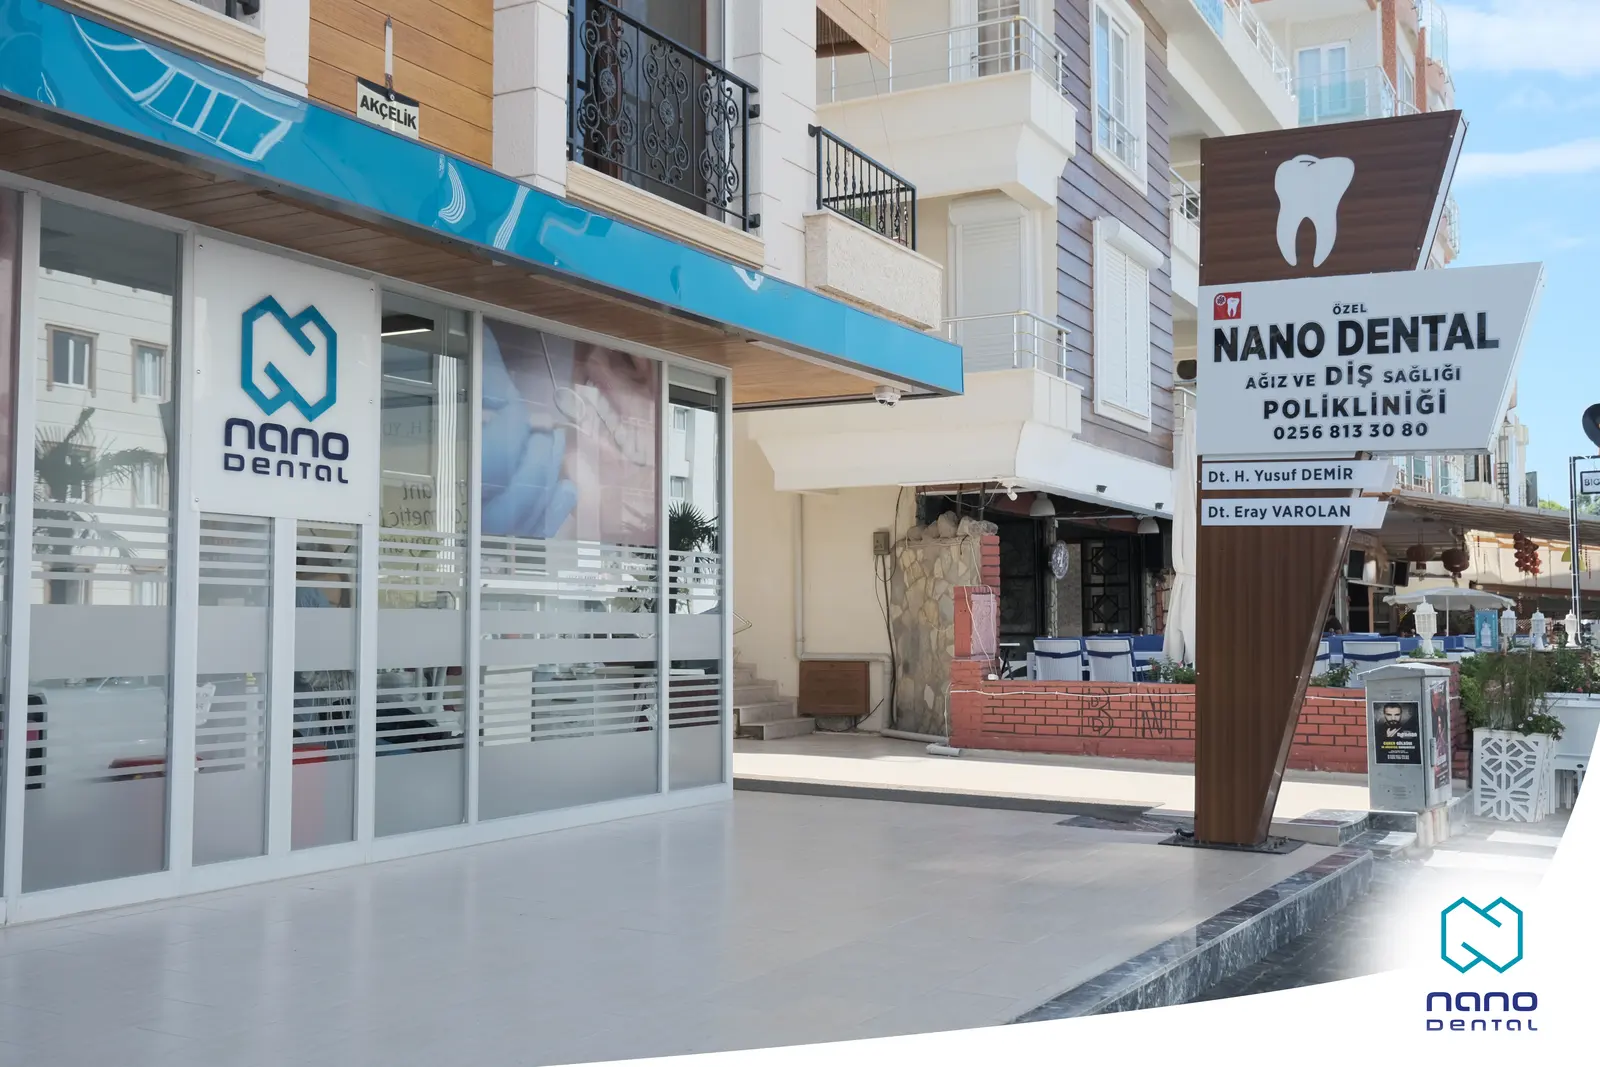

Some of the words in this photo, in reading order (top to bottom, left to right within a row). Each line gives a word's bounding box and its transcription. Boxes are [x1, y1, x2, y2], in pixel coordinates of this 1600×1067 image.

[360, 95, 417, 130] AKÇELİK
[1332, 303, 1367, 315] ÖZEL
[1214, 322, 1325, 362] NANO
[1338, 312, 1499, 356] DENTAL
[1245, 372, 1288, 389] AĞIZ
[1293, 374, 1316, 388] VE
[1325, 361, 1373, 388] DİŞ
[1383, 364, 1461, 383] SAĞLIĞI
[1264, 388, 1446, 419] POLİKLİNİĞİ
[1273, 425, 1322, 440] 0256
[1329, 424, 1362, 438] 813
[1370, 423, 1394, 437] 30
[1401, 422, 1428, 437] 80
[1208, 470, 1230, 483] Dt.
[1235, 470, 1249, 482] H.
[1255, 468, 1296, 481] Yusuf
[1301, 465, 1353, 481] DEMİR
[1208, 506, 1230, 518] Dt.
[1235, 505, 1267, 520] Eray
[1272, 505, 1350, 518] VAROLAN
